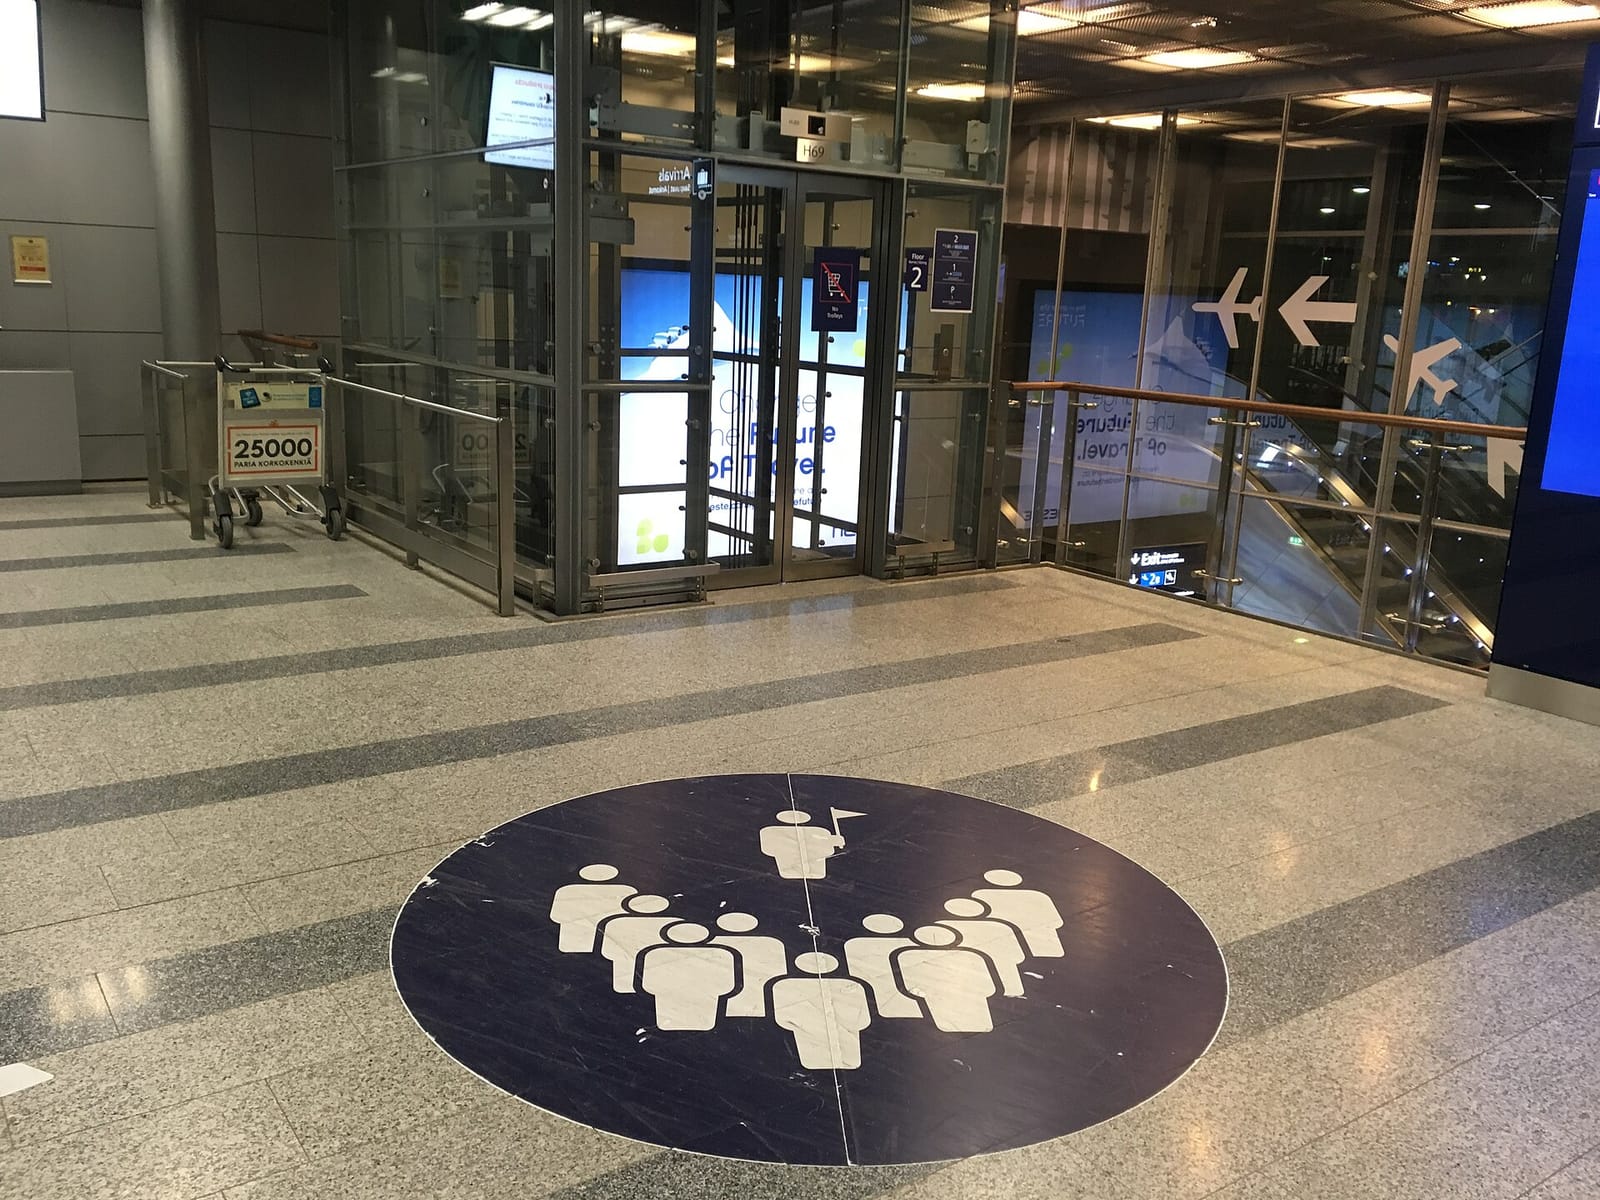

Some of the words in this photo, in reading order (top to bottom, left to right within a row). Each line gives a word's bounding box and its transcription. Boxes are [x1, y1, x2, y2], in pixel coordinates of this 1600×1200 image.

[803, 144, 825, 159] H69
[953, 234, 959, 244] 2
[910, 266, 922, 288] 2
[234, 438, 312, 459] 25000
[1141, 551, 1162, 567] Exit
